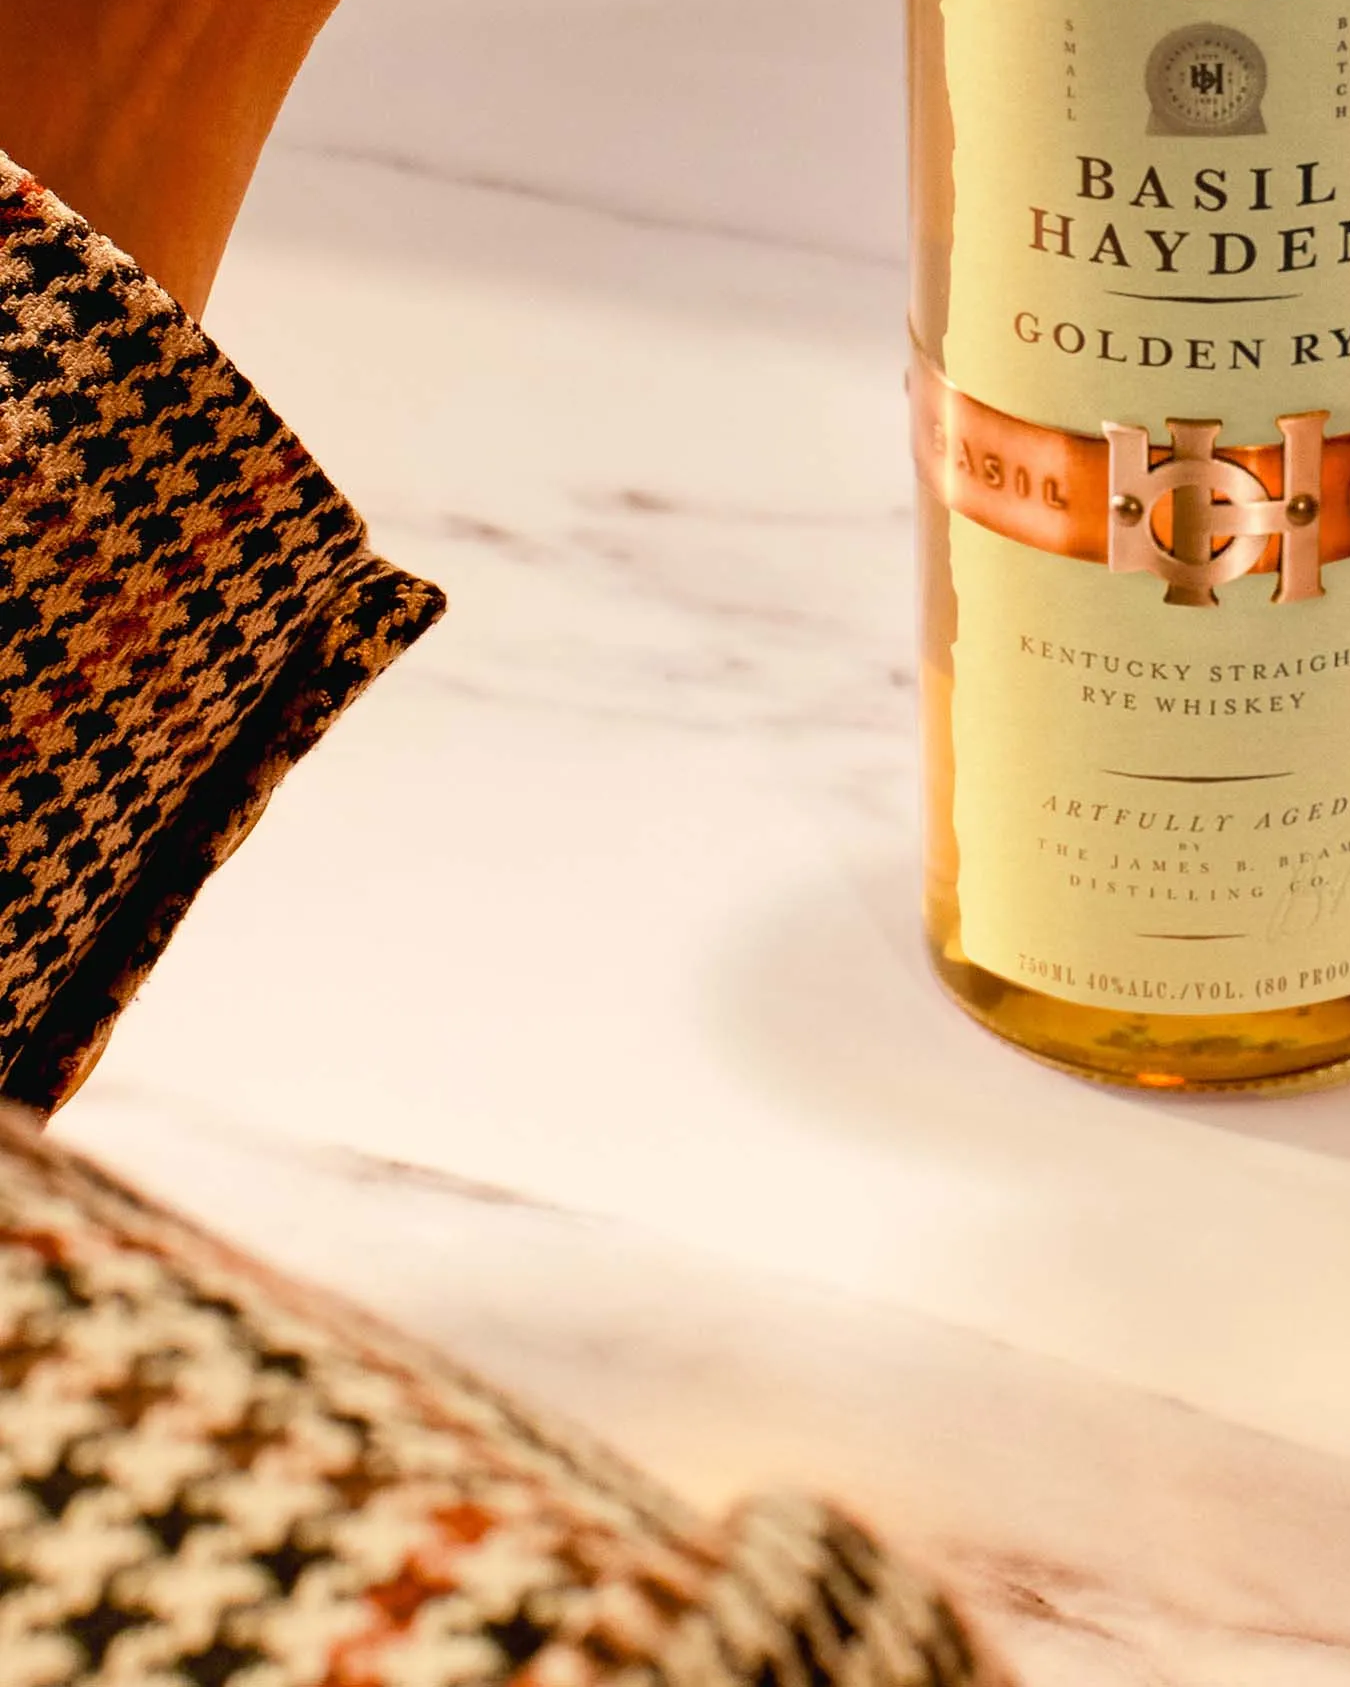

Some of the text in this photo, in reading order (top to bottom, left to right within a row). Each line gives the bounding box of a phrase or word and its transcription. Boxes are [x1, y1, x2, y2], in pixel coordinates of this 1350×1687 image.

[1063, 18, 1077, 122] SMALL
[1336, 16, 1349, 119] BATCH
[1076, 155, 1336, 212] BASIL
[1013, 311, 1266, 370] GOLDEN
[1020, 635, 1191, 682] KENTUCKY
[1081, 685, 1306, 716] RYE WHISKEY
[1042, 795, 1348, 833] ARTFULLY AGED
[1037, 837, 1089, 861] THE
[1110, 854, 1210, 874] JAMES
[1069, 874, 1264, 902] DISTILLING
[1018, 952, 1076, 987] 750ML
[1255, 976, 1288, 999] (80
